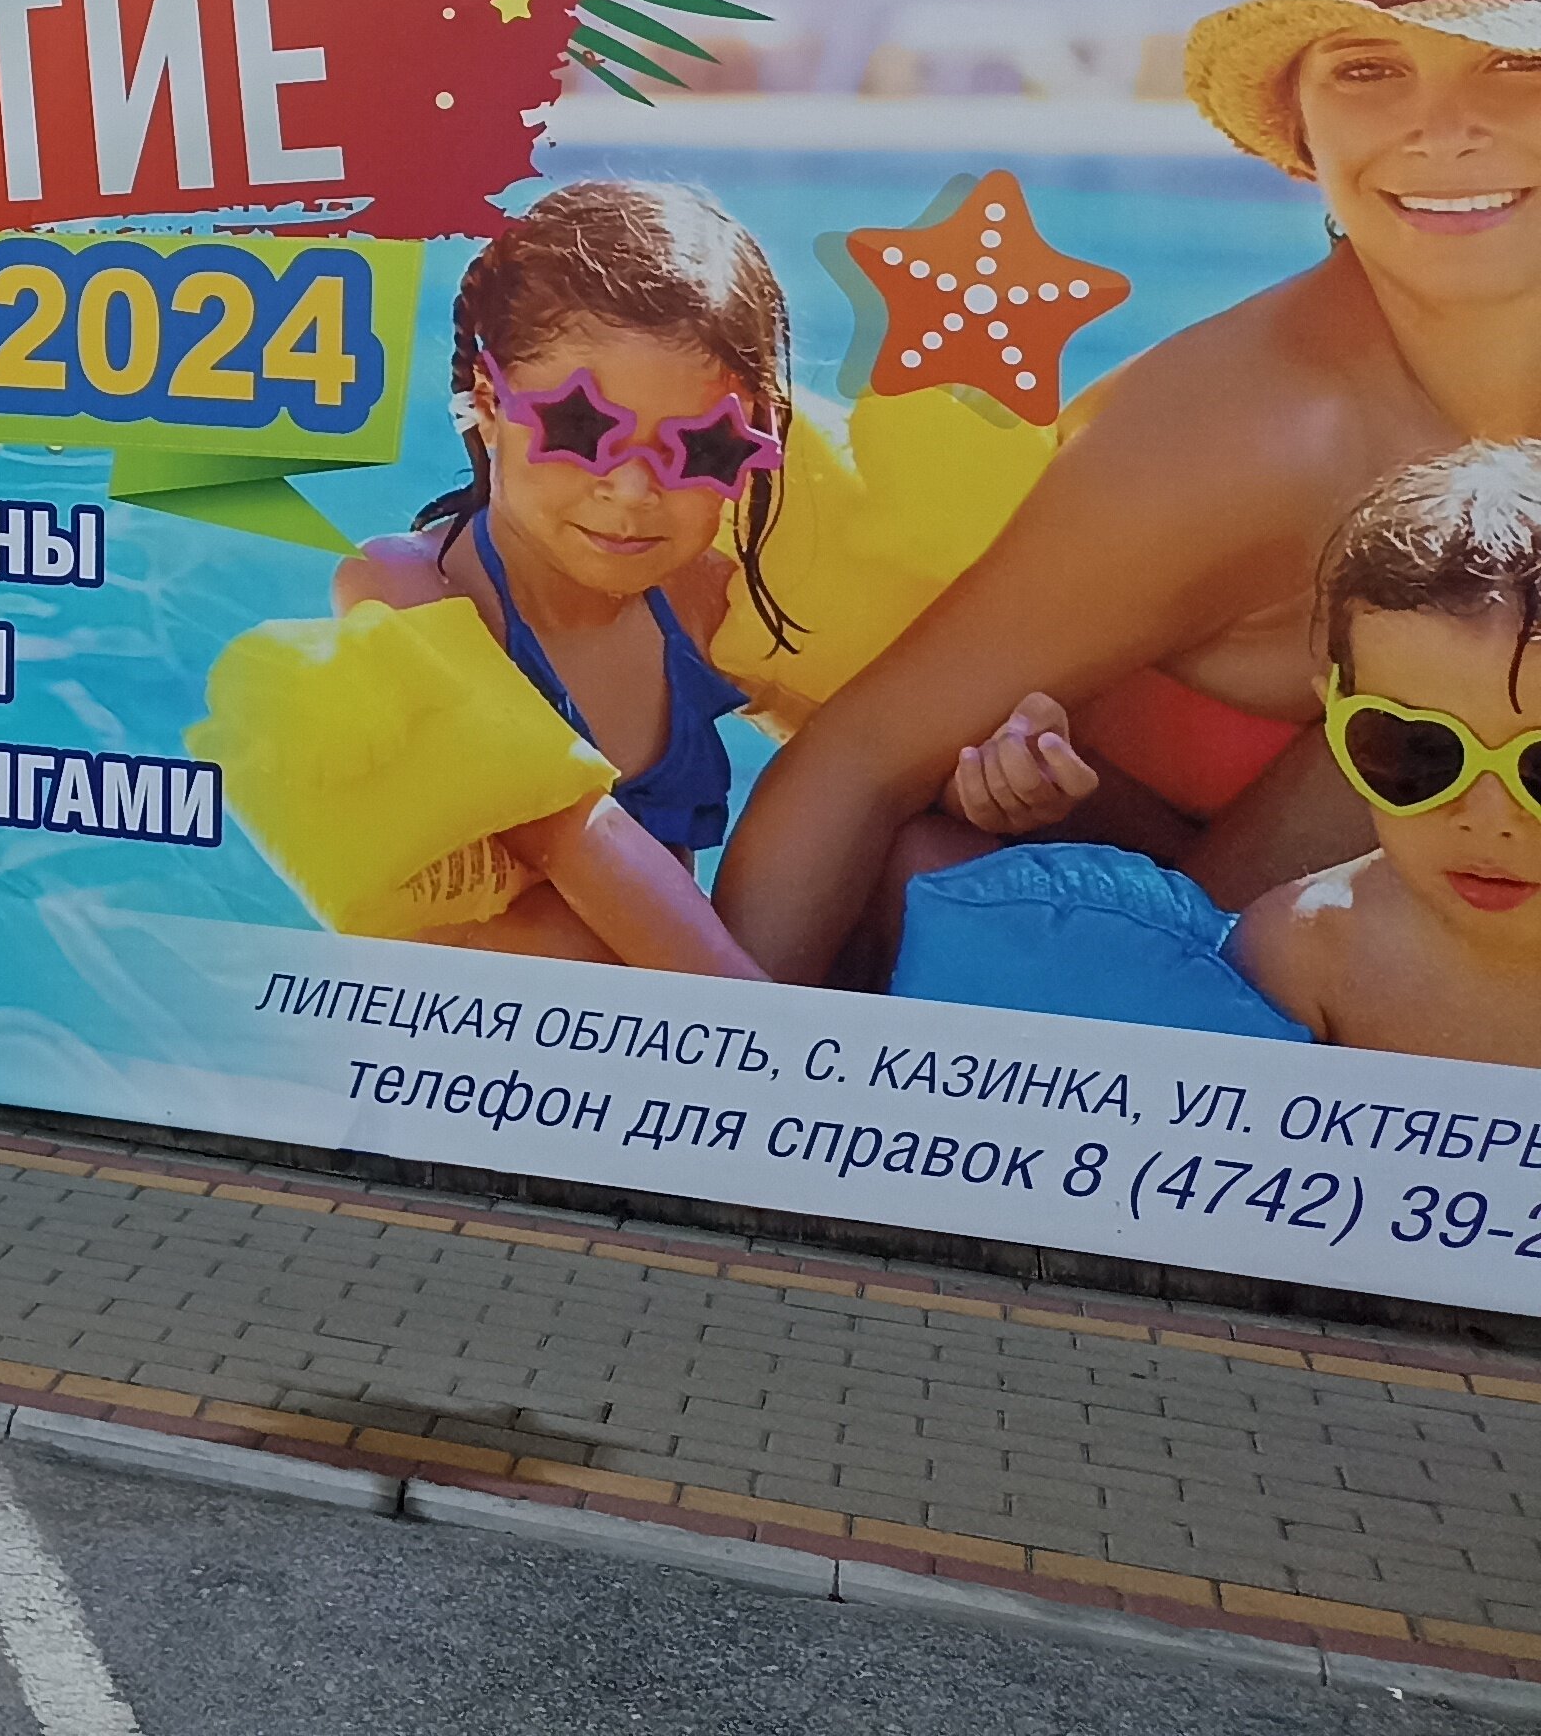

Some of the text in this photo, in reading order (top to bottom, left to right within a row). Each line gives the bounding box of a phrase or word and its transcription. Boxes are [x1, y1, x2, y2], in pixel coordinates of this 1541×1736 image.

[255, 972, 523, 1044] ЛИПЕЦКАЯ
[534, 1005, 781, 1082] ОБЛАСТЬ,
[804, 1037, 848, 1084] С.
[868, 1045, 1143, 1126] КАЗИНКА,
[1168, 1079, 1252, 1134] УЛ.
[348, 1060, 613, 1133] телефон
[623, 1098, 749, 1152] для
[767, 1115, 1046, 1191] справок
[1062, 1141, 1110, 1199] 8
[1129, 1150, 1364, 1248] (4742)
